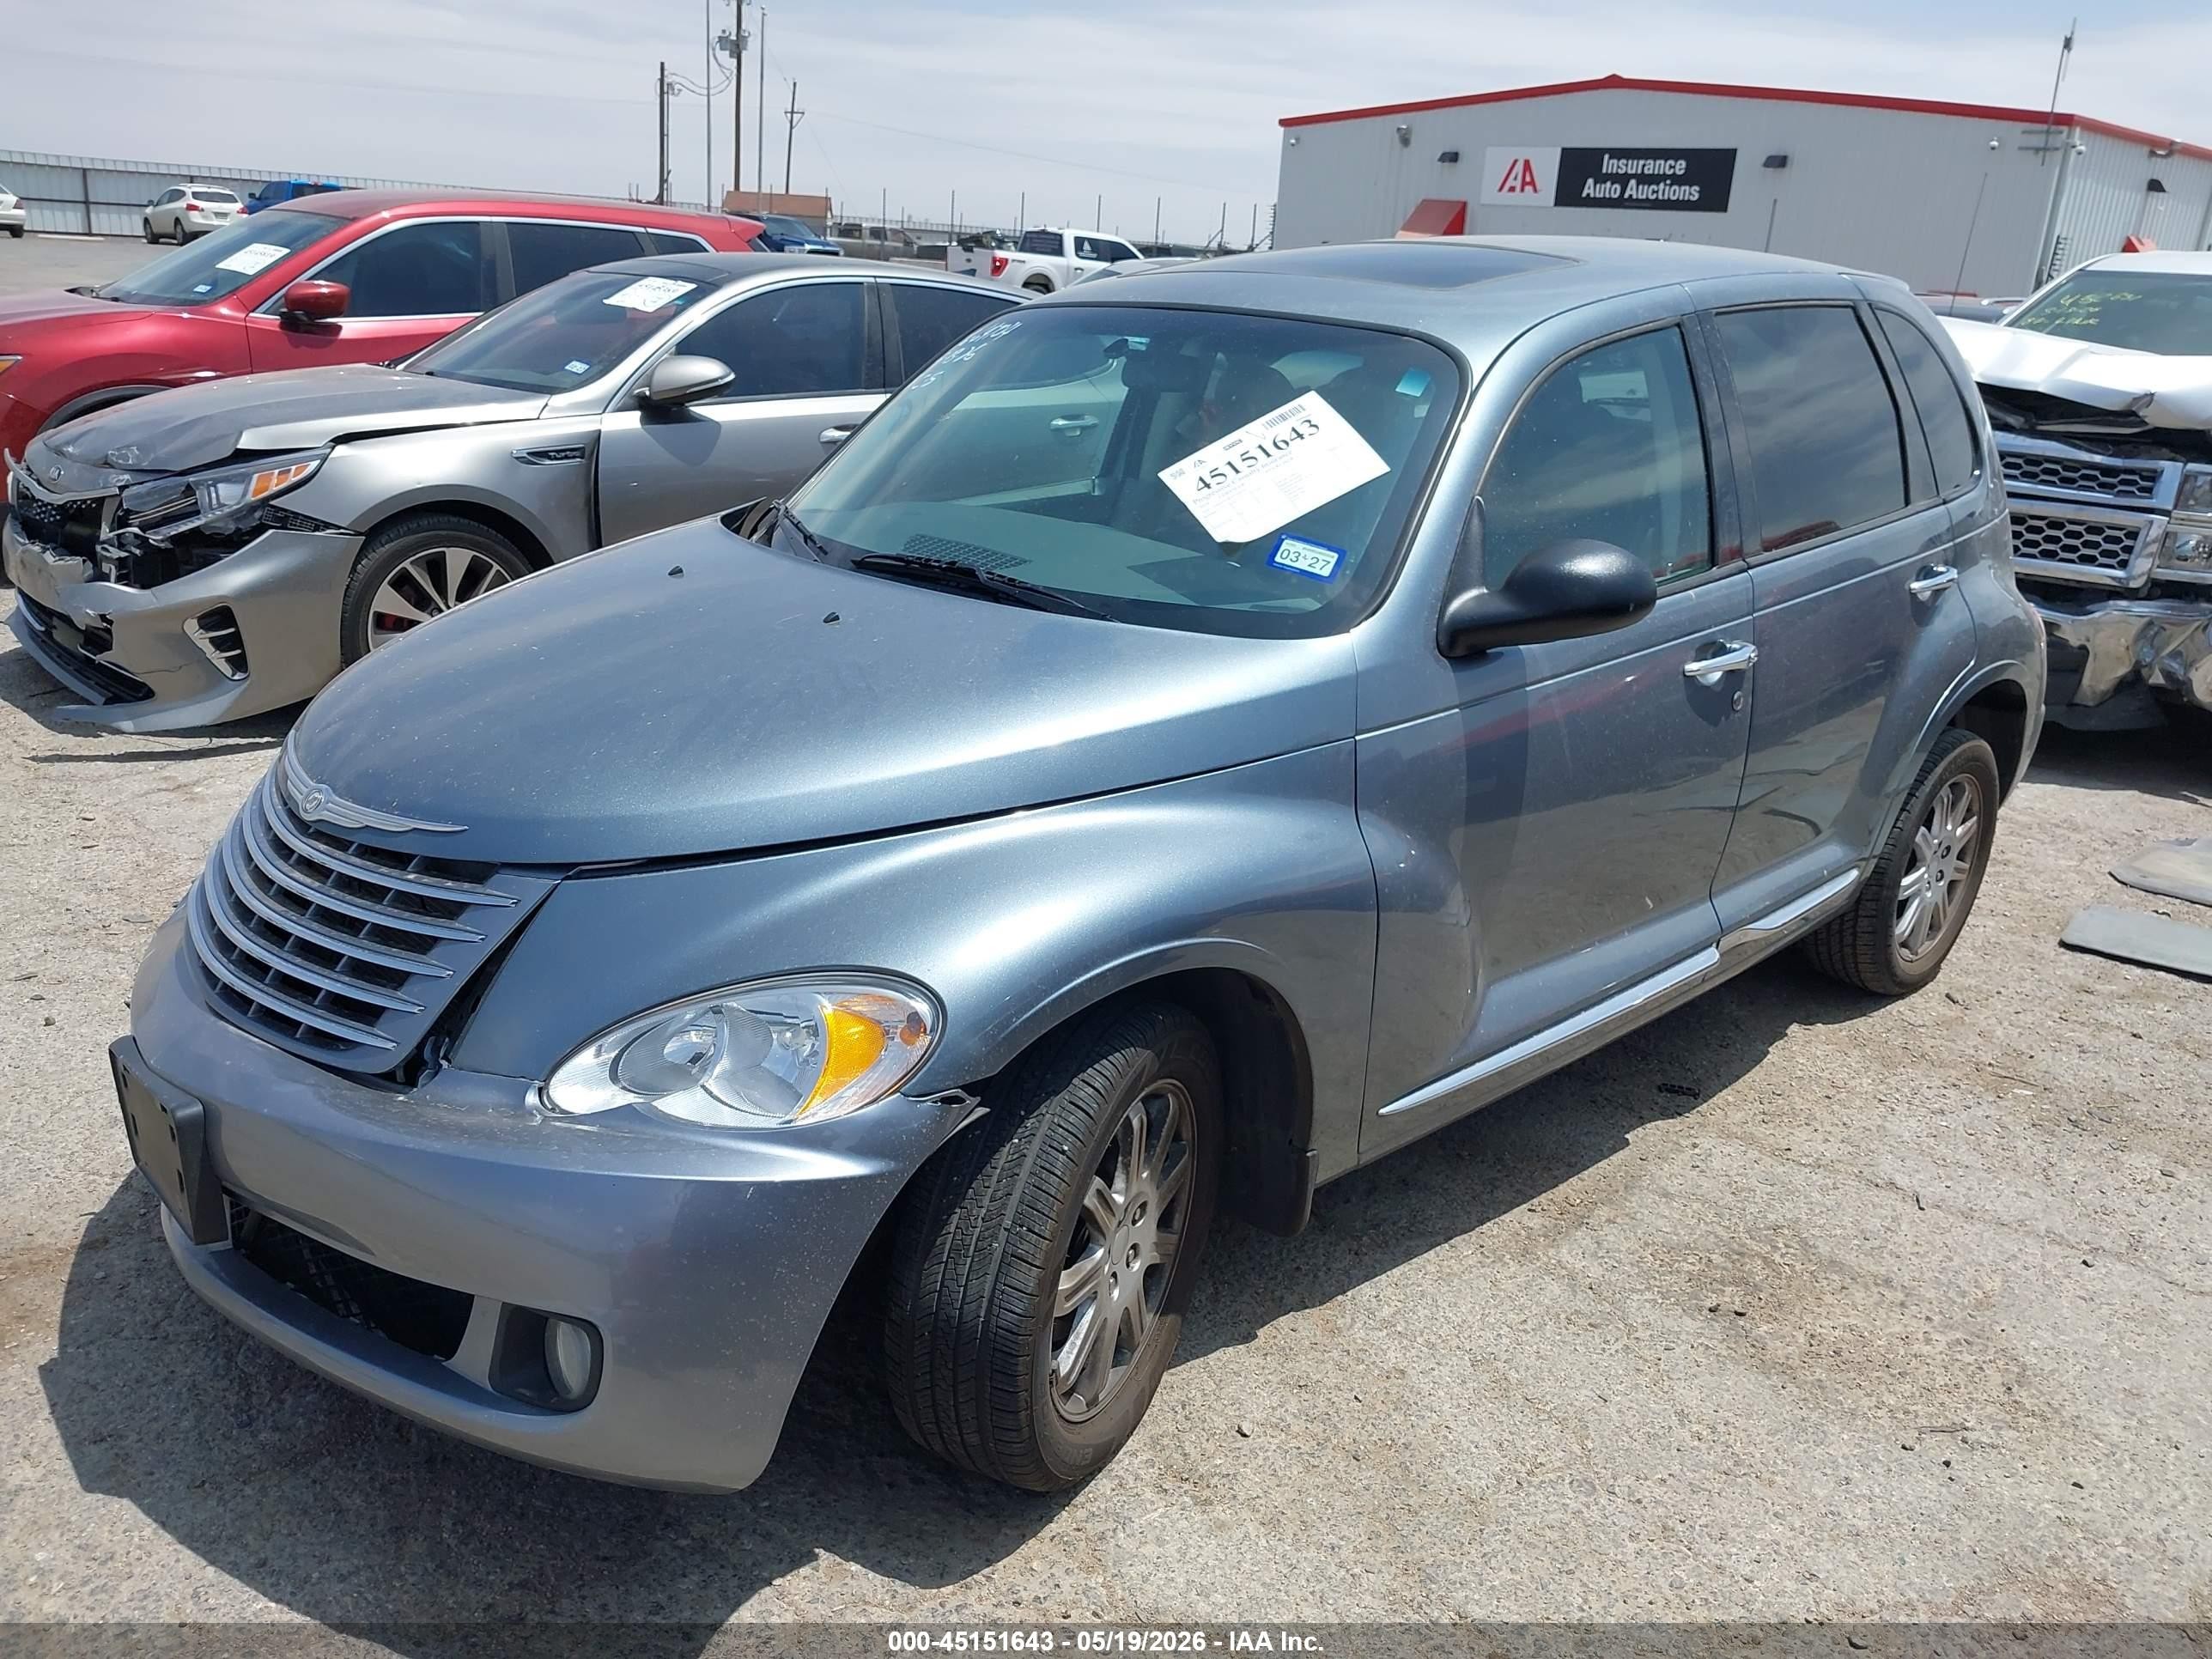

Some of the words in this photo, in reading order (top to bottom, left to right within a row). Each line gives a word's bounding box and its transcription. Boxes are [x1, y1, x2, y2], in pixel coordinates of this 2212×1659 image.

[1601, 153, 1686, 176] Insurance
[1581, 177, 1622, 199] Auto
[1623, 179, 1700, 202] Auctions
[1196, 418, 1321, 493] 45151643
